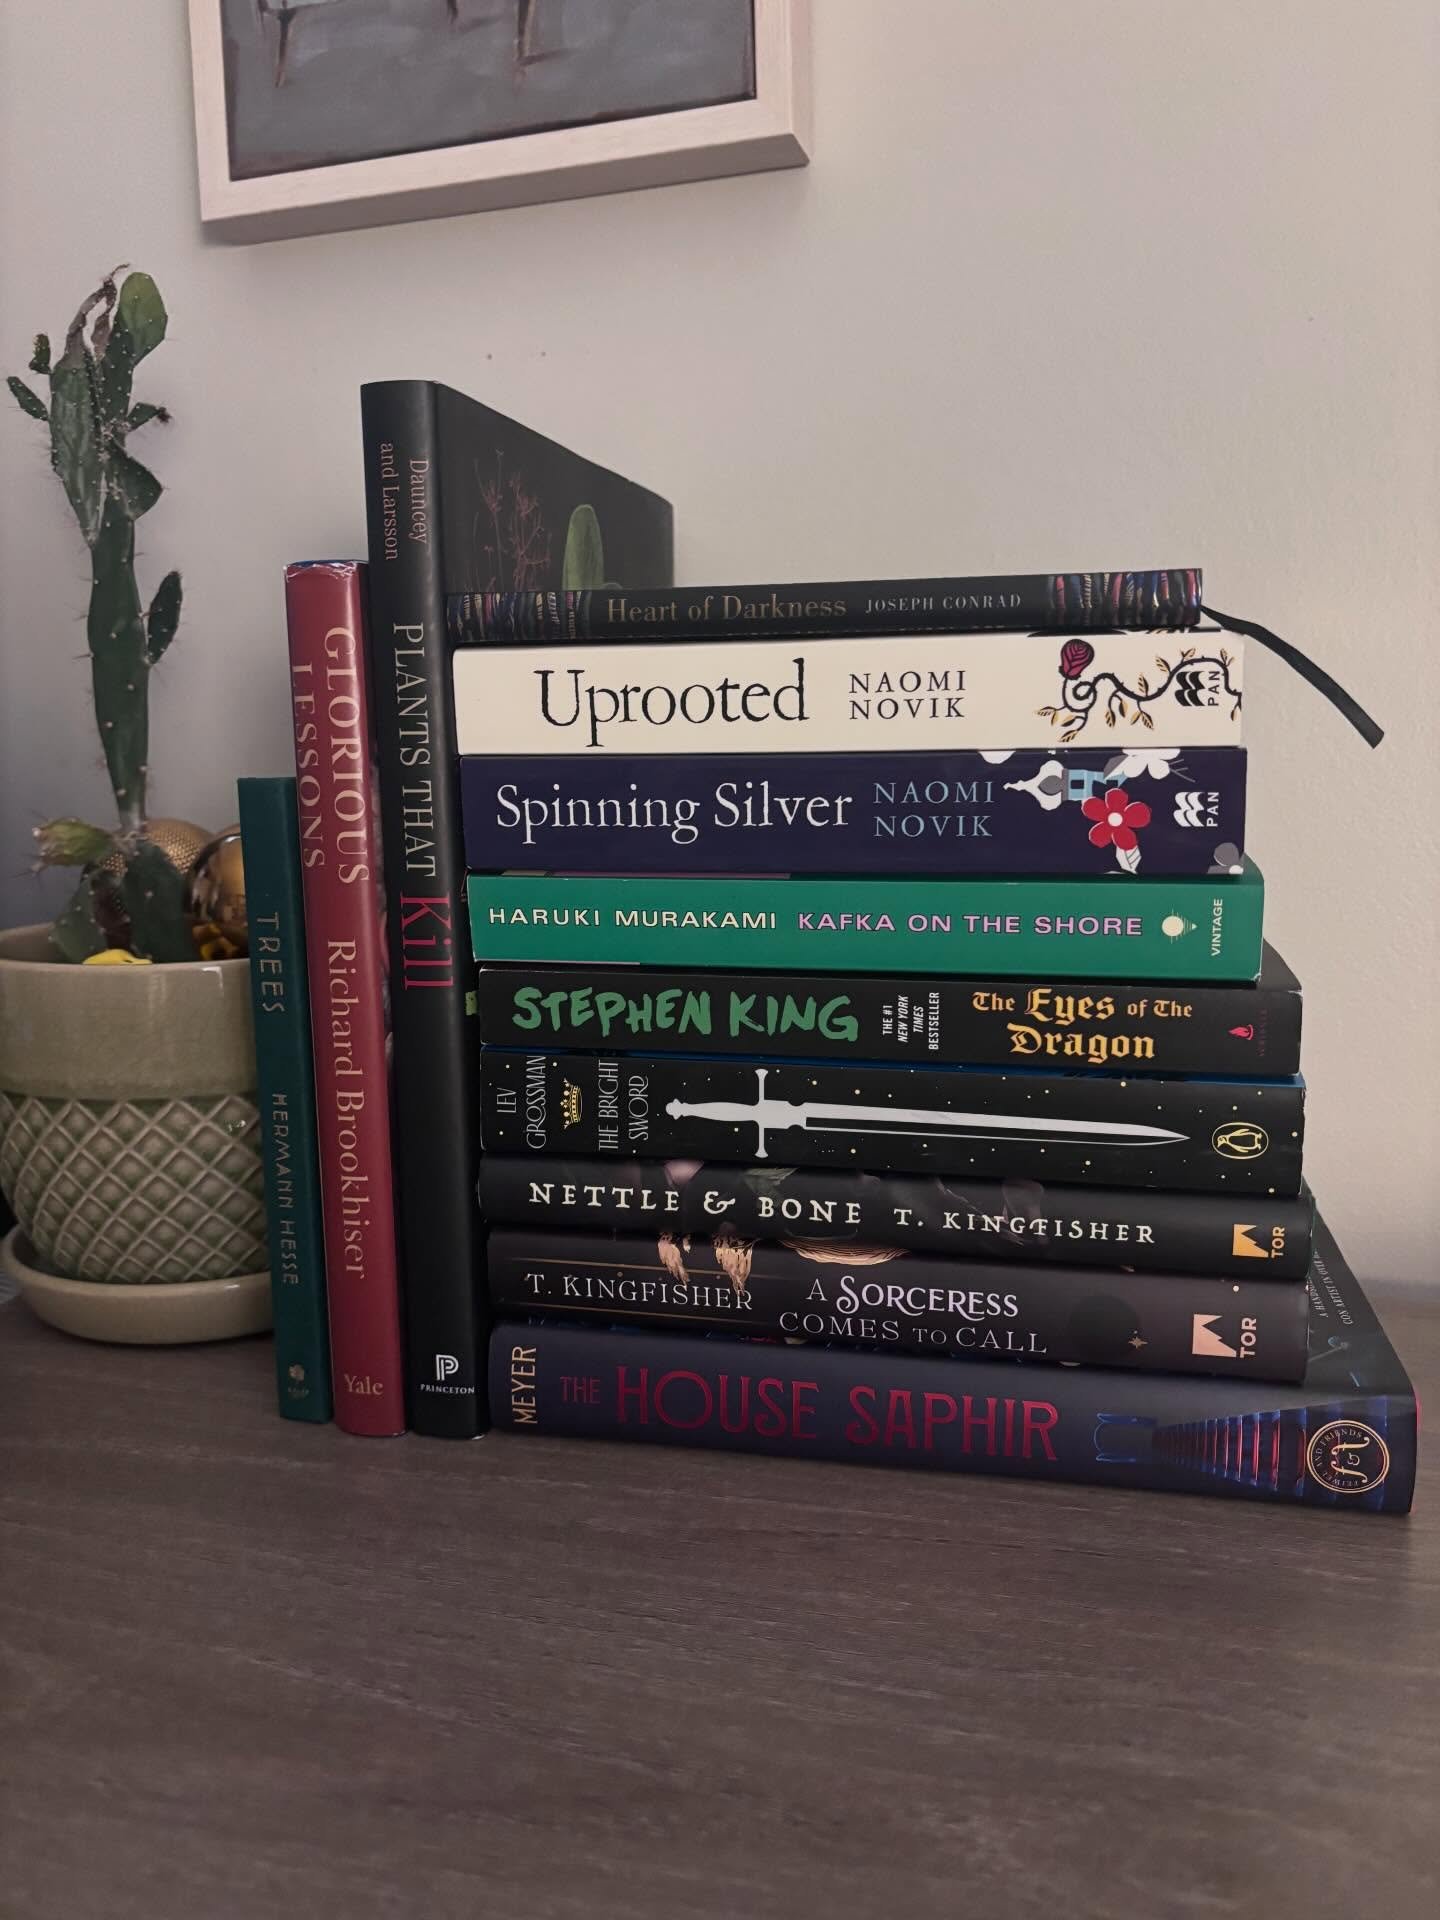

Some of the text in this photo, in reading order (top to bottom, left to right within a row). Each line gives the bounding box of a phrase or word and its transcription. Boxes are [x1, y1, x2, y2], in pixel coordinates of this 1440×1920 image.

[379, 443, 400, 561] and Larsson
[407, 459, 430, 545] Dauncey
[607, 593, 848, 623] Heart of Darkness
[865, 593, 1022, 613] JOSEPH CONRAD
[533, 657, 810, 748] Uprooted
[848, 670, 967, 694] NAOMI
[1206, 670, 1221, 707] PAN
[848, 696, 966, 721] NOVIK
[292, 663, 325, 870] LESSONS
[323, 626, 369, 885] GLORIOUS
[394, 622, 455, 991] PLANTS THAT Kill
[495, 780, 853, 845] Spinning Silver
[873, 781, 995, 804] NAOMI
[1205, 791, 1220, 828] PAN
[873, 814, 993, 838] NOVIK
[488, 907, 777, 930] HARUKI MURAKAMI
[797, 912, 1143, 936] KAFKA ON THE SHORE
[1211, 898, 1224, 957] VINTAGE
[256, 912, 285, 1015] TREES
[511, 985, 860, 1042] STEPHEN KING
[882, 1005, 893, 1035] THE #1
[897, 994, 909, 1043] NEW YORK
[912, 1005, 924, 1033] TIMES
[928, 992, 940, 1050] BESTSELLER
[972, 988, 1193, 1026] The Eyes of The
[1006, 1023, 1156, 1064] Dragon
[327, 937, 370, 1281] Richard Brookhiser
[496, 1087, 517, 1114] LEV
[525, 1055, 547, 1150] GROSSMAN
[598, 1059, 619, 1151] THE BRIGHT
[628, 1074, 649, 1141] SWORD
[272, 1091, 299, 1286] HERMANN HESSE
[528, 1182, 862, 1224] NETTLE & BONE
[894, 1208, 1156, 1244] T. KINGFISHER
[1270, 1226, 1286, 1259] TOR
[526, 1273, 753, 1311] T. KINGFISHER
[806, 1275, 1019, 1322] A SORCERESS
[779, 1311, 1048, 1354] COMES TO CALL
[1240, 1316, 1257, 1360] TOR
[344, 1373, 385, 1396] Yale
[420, 1383, 476, 1396] PRINCETON
[511, 1345, 538, 1425] MEYER
[559, 1365, 1060, 1462] THE HOUSE SAPHIR
